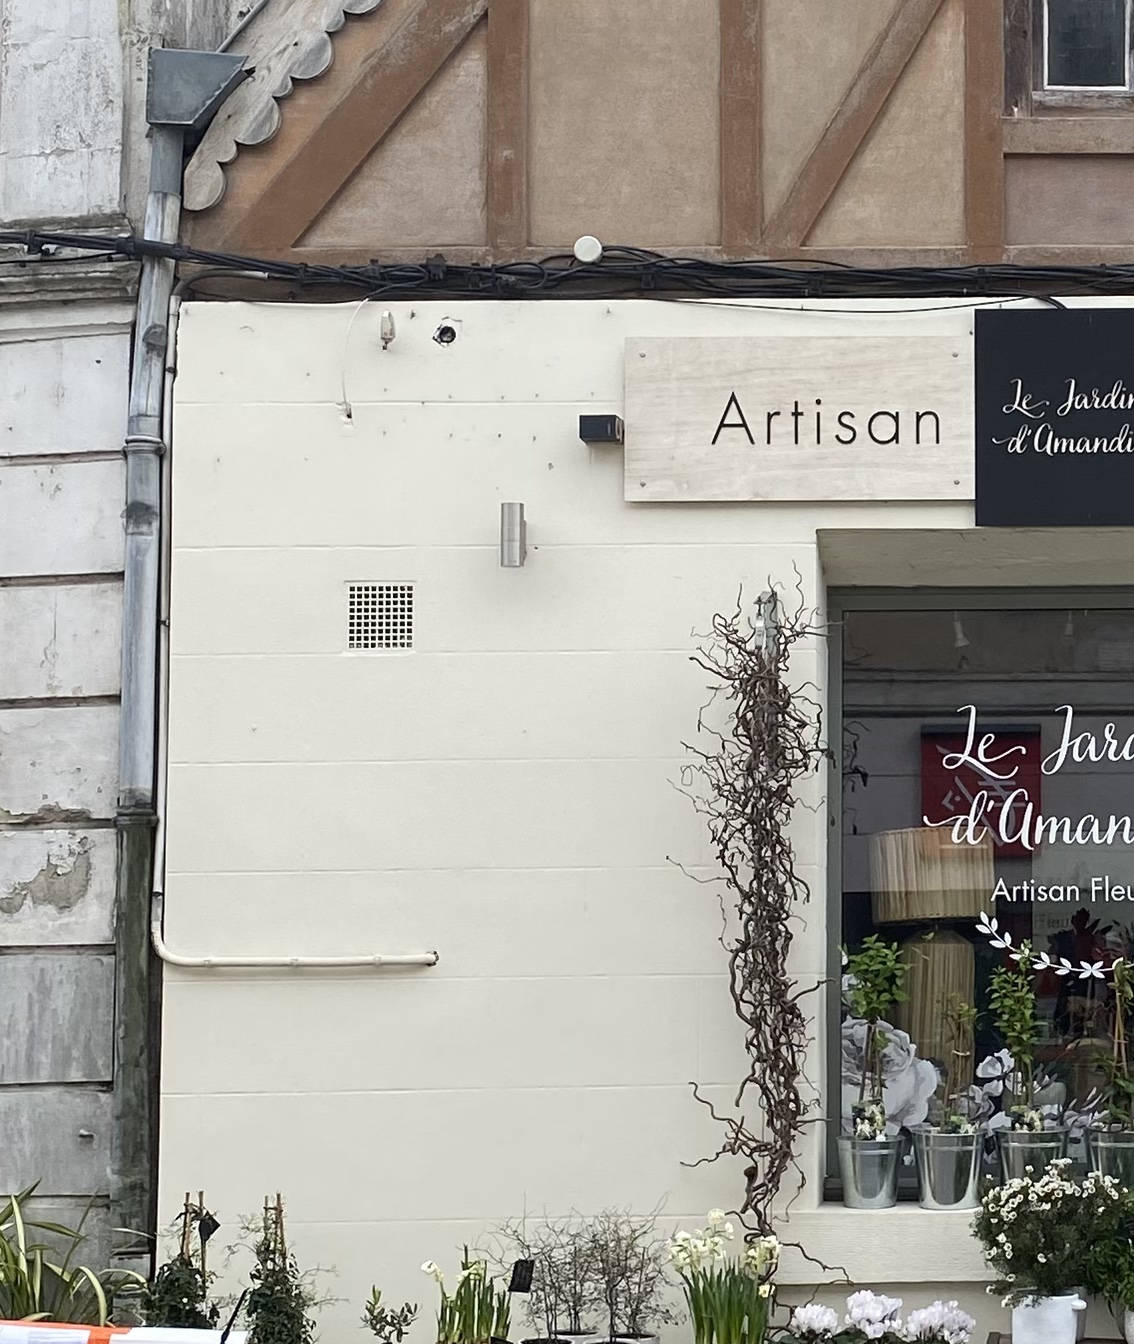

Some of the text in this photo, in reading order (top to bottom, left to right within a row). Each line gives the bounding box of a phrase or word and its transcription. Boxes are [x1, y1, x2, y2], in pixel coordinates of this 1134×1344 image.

[711, 390, 943, 446] Artisan
[1002, 378, 1050, 419] Le
[942, 705, 1026, 779] Le
[990, 877, 1080, 902] Artisan
